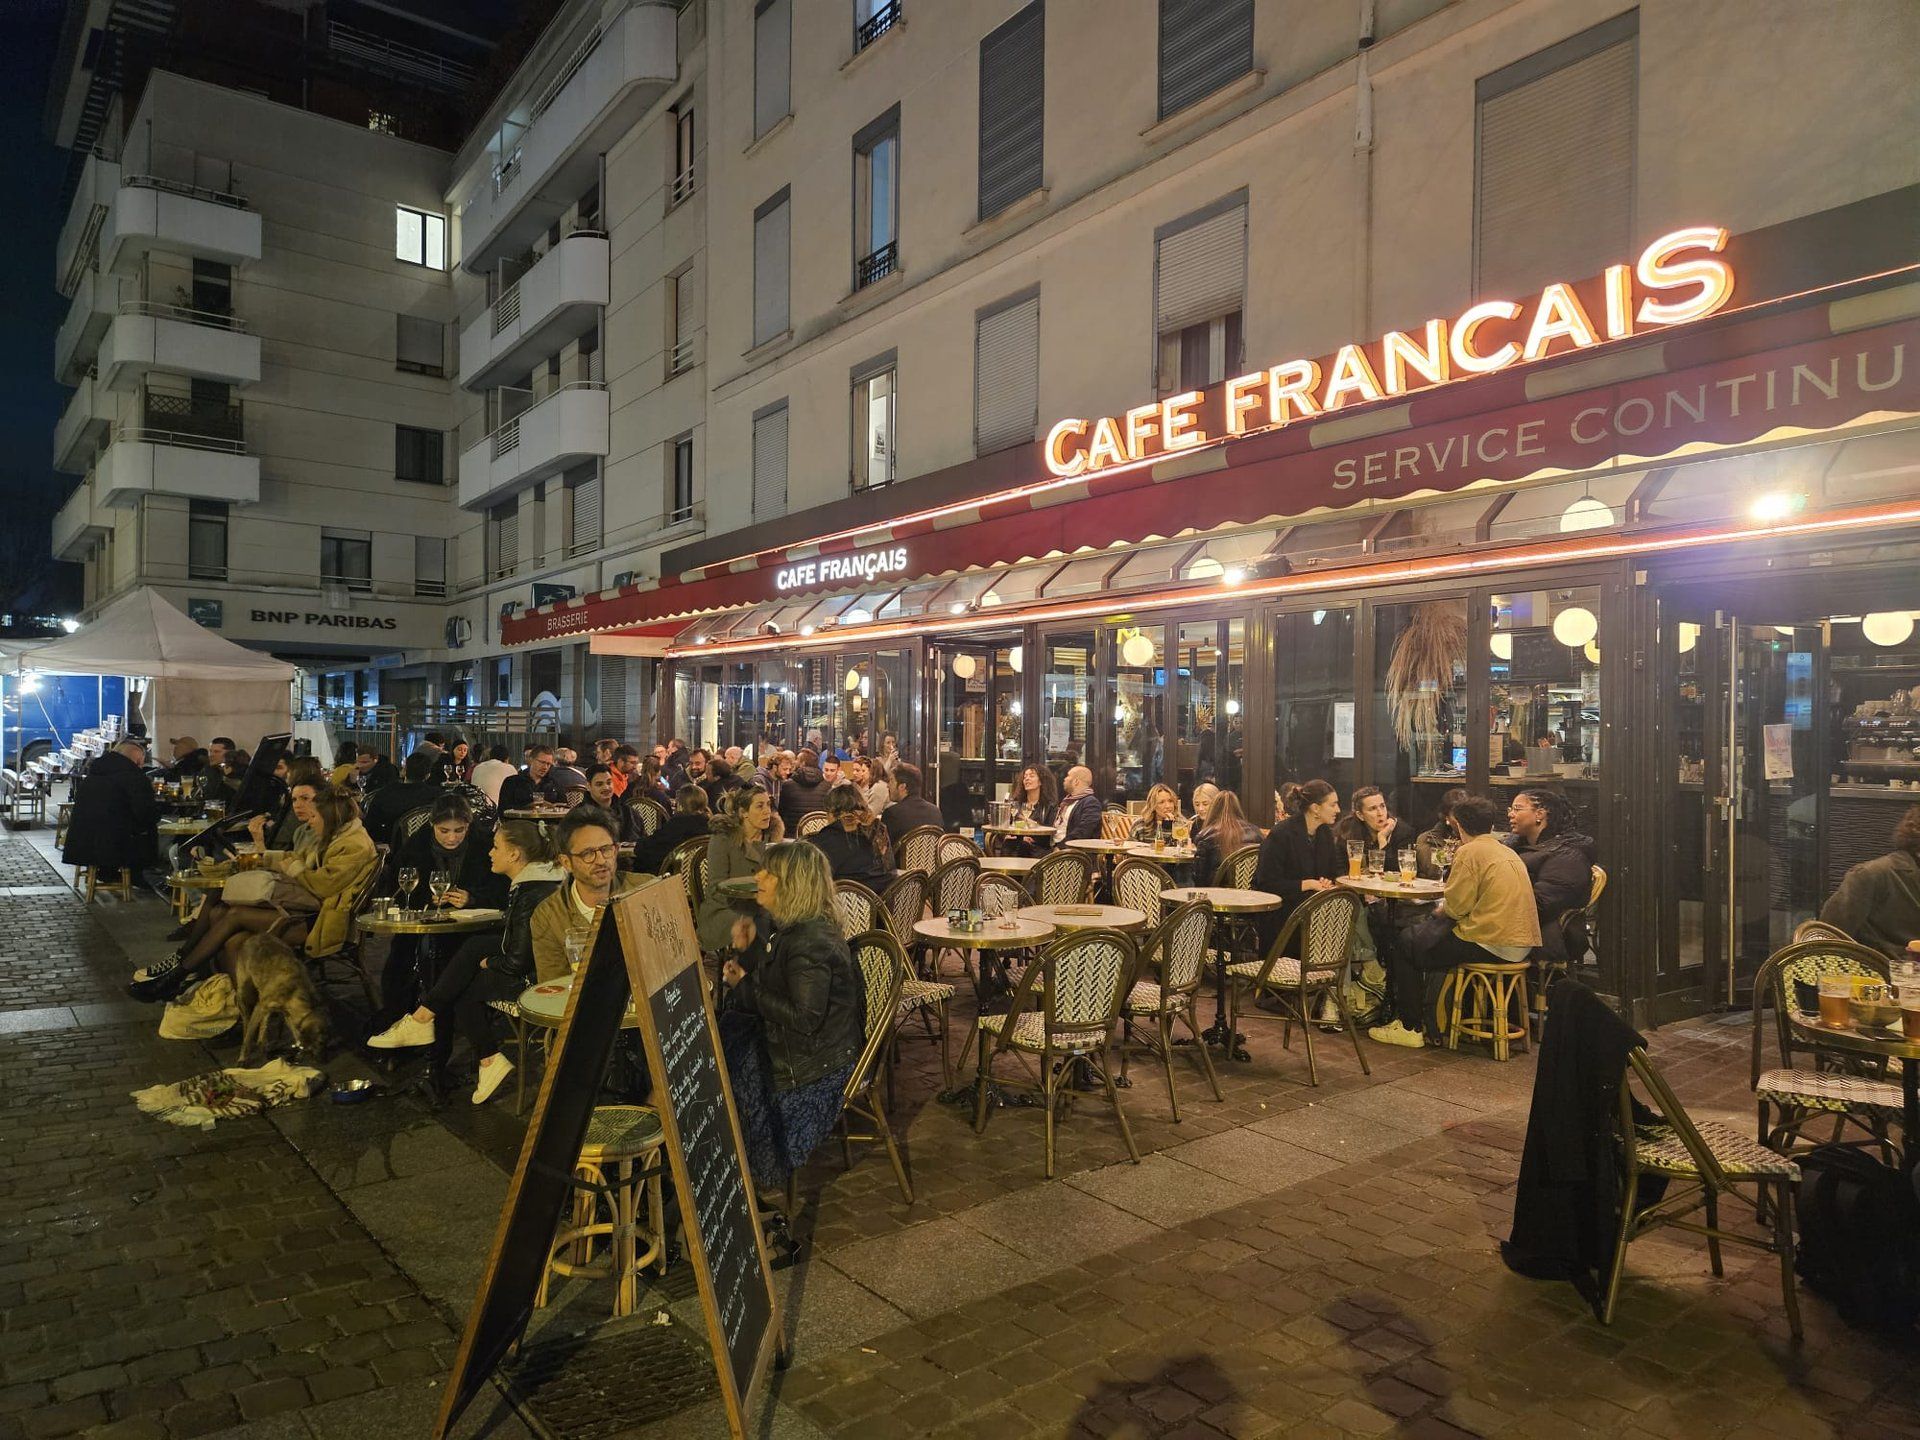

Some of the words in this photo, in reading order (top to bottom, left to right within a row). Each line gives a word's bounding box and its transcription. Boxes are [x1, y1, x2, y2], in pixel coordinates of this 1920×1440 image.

[1044, 391, 1207, 477] CAFE
[1224, 226, 1735, 435] FRANCAIS
[1332, 419, 1547, 491] SERVICE
[1570, 344, 1907, 446] CONTINU
[776, 563, 816, 590] CAFE
[819, 547, 908, 581] FRANÇAIS
[250, 609, 299, 624] BNP
[304, 613, 397, 630] PARIBAS
[547, 610, 589, 632] BRASSERIE
